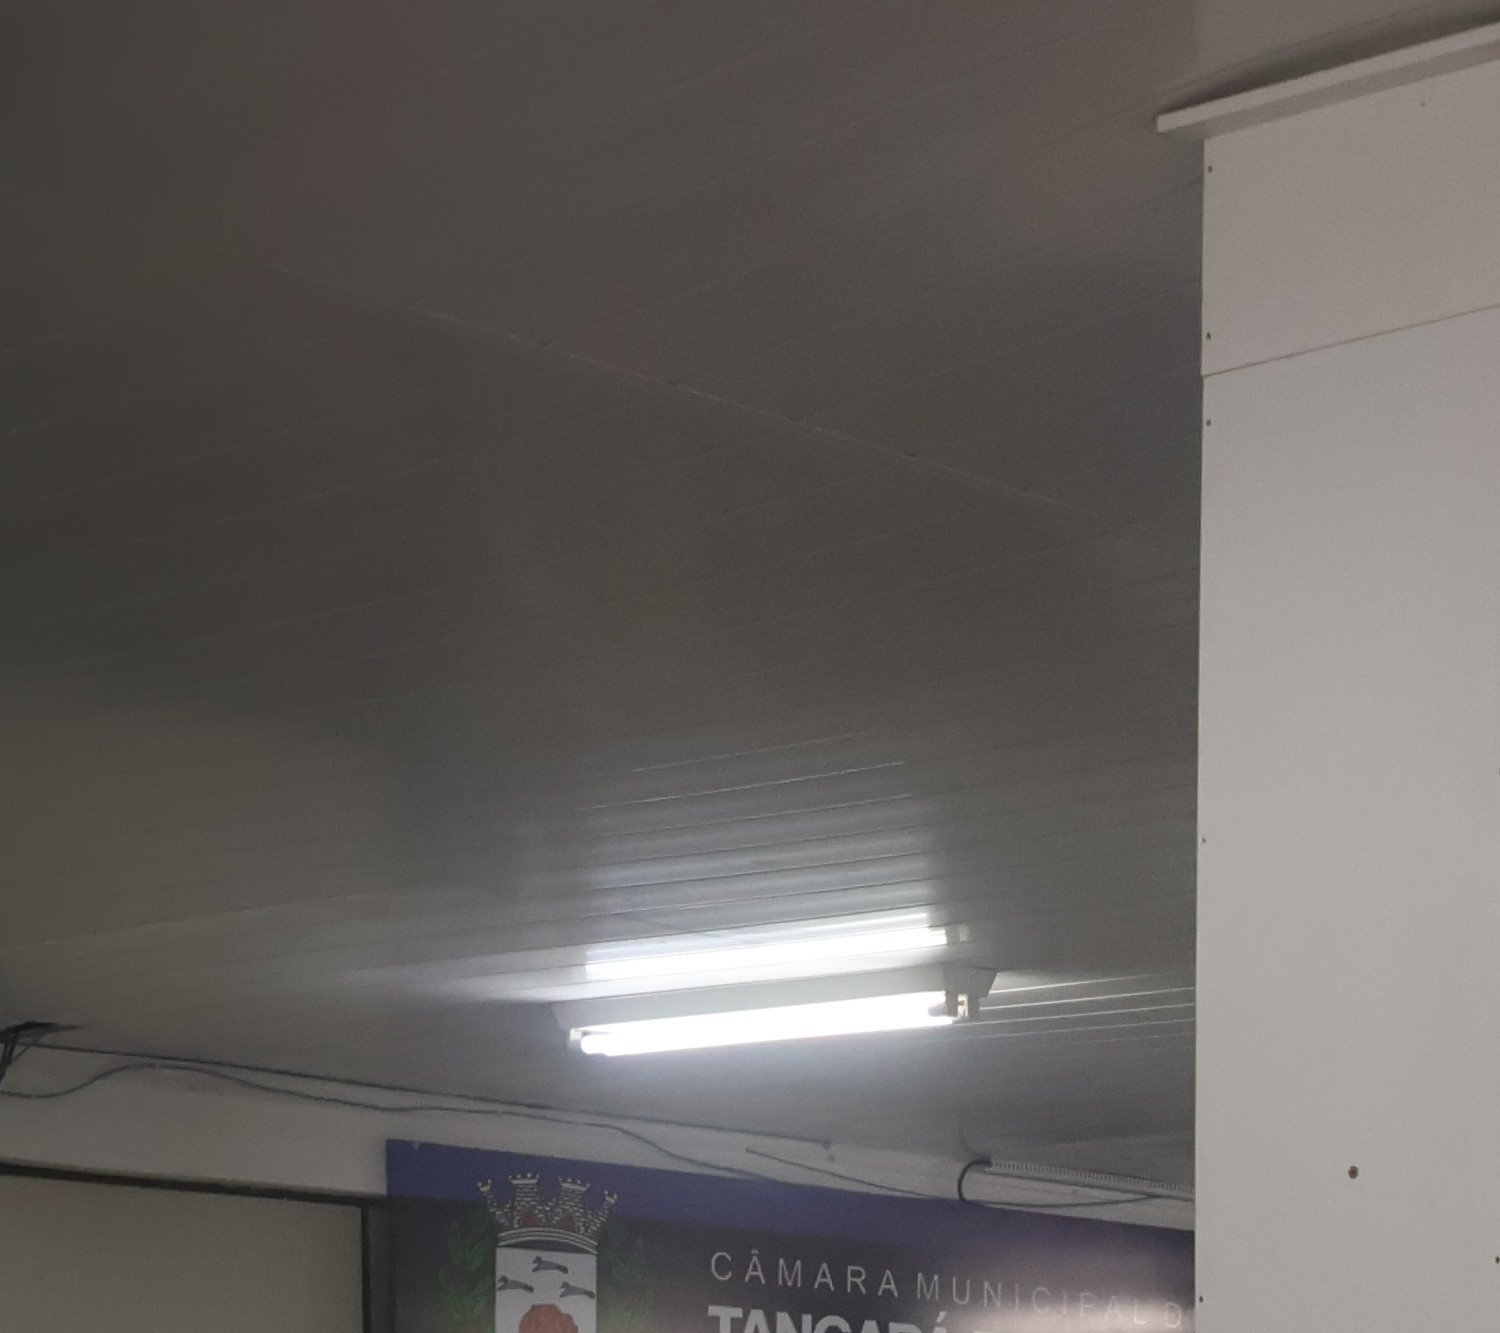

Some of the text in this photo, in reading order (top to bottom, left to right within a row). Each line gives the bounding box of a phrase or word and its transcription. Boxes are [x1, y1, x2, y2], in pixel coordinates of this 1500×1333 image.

[711, 1250, 1183, 1328] CÂMARA MUNICIPAL D
